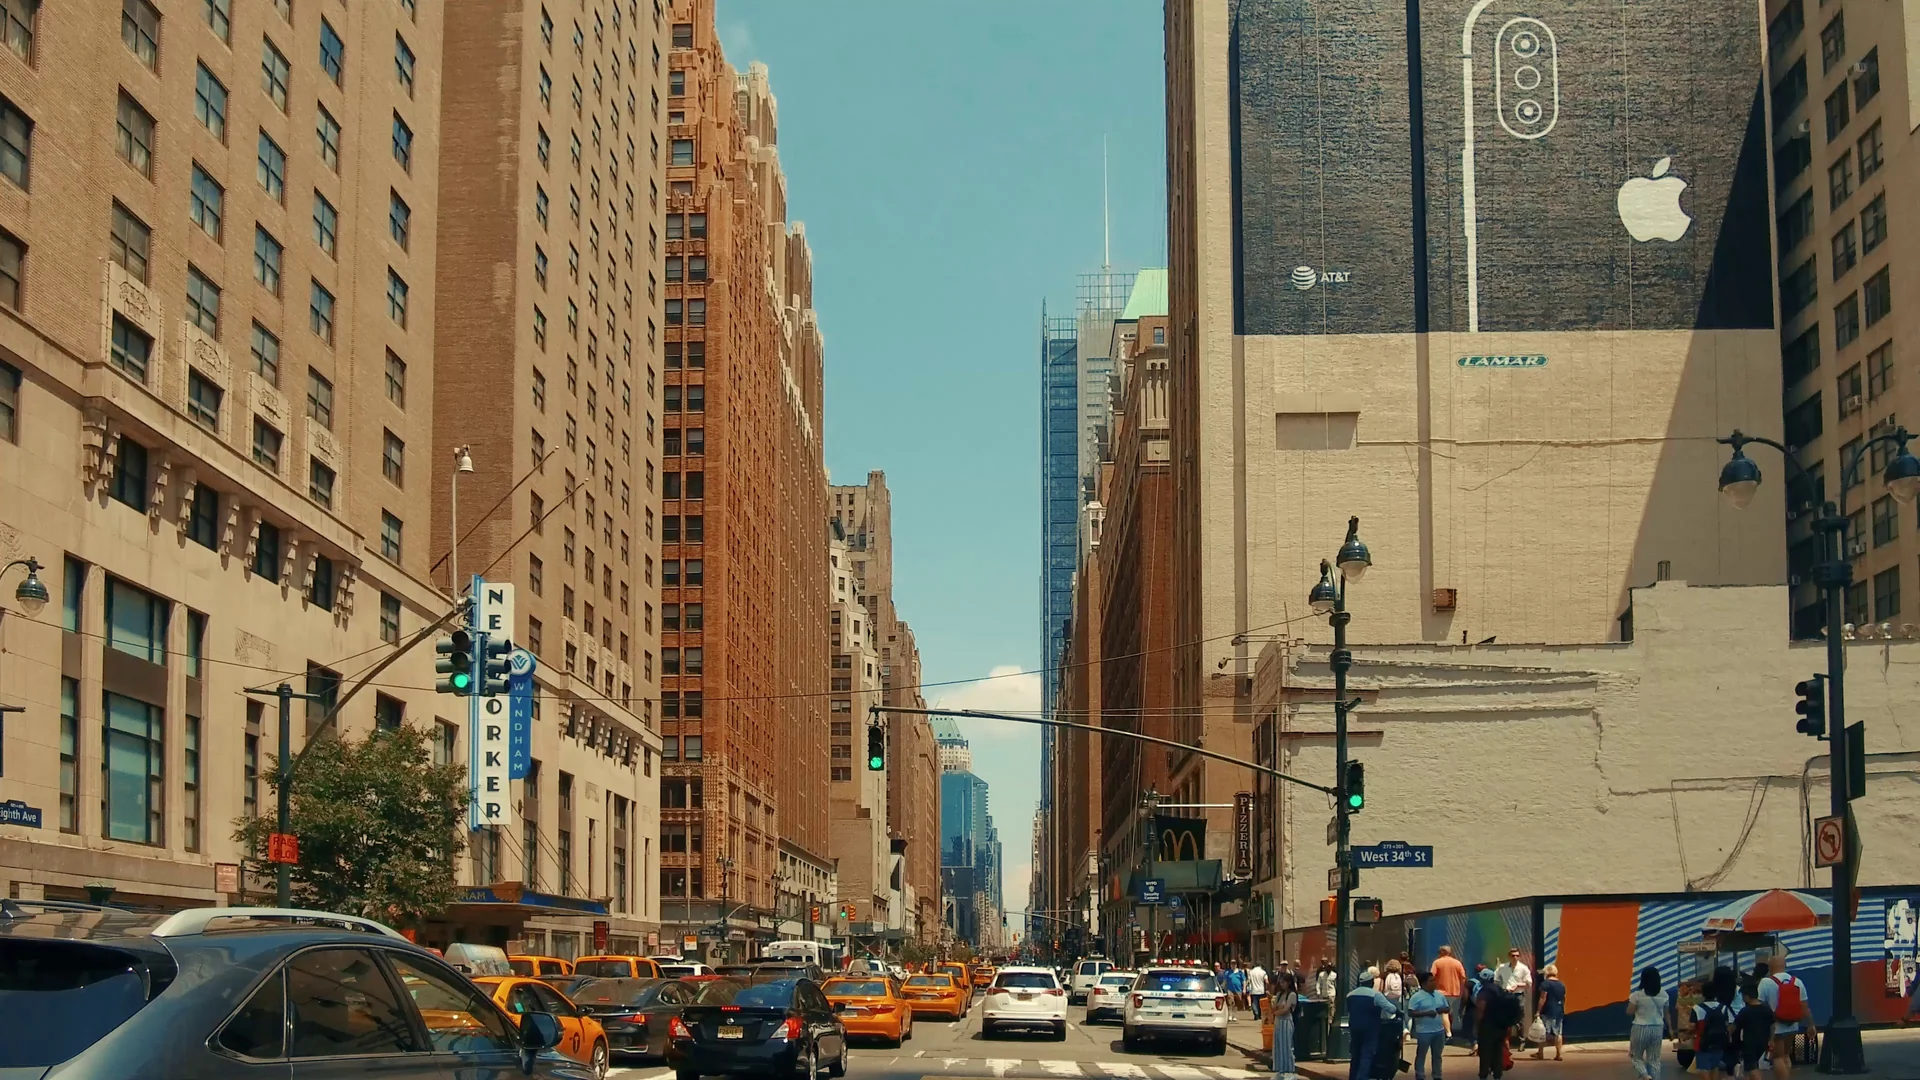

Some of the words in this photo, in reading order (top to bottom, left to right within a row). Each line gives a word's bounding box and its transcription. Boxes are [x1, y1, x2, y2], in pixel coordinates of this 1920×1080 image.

[1321, 272, 1351, 282] AT&T
[1464, 357, 1540, 366] LAMAR
[488, 589, 503, 634] NE
[513, 682, 525, 771] WYNDHAM
[486, 698, 502, 818] ORKER
[0, 807, 20, 821] ighth
[22, 811, 37, 823] Ave
[1239, 797, 1248, 867] PIZZERIA
[273, 849, 297, 860] PLOW
[1360, 850, 1389, 862] West
[1391, 850, 1412, 862] 34th
[1414, 850, 1427, 862] St
